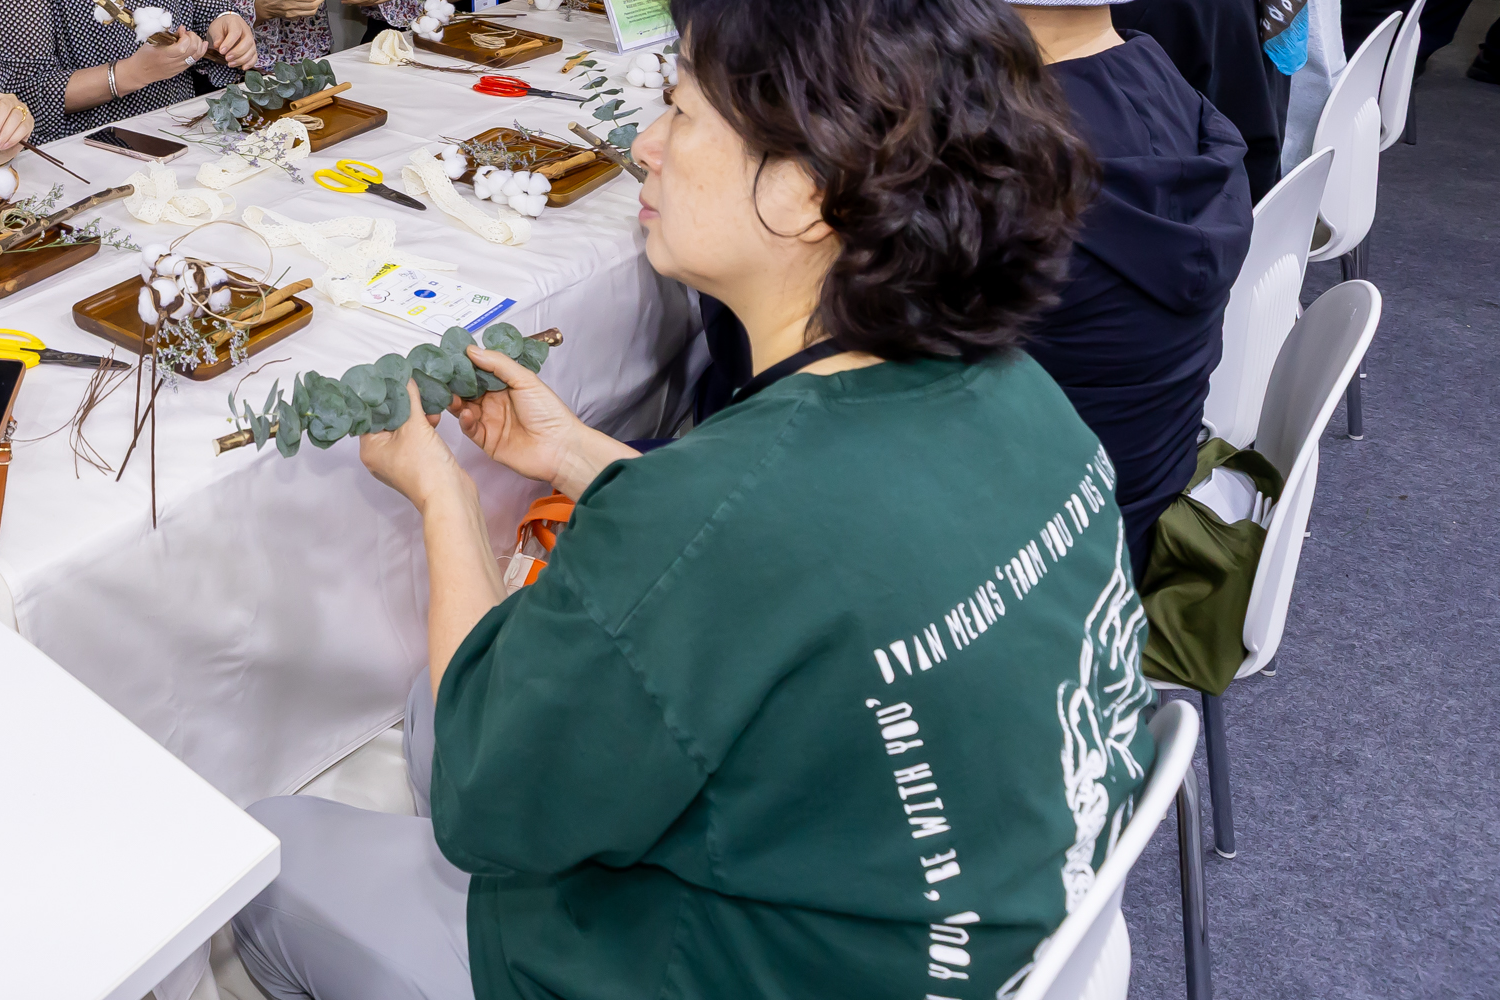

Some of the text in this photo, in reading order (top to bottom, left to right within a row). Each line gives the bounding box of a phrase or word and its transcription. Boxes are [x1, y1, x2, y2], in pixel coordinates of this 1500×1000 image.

[944, 579, 1006, 651] MEANS
[1039, 512, 1074, 563] YOU
[1064, 492, 1090, 535] TO
[893, 762, 952, 839] WITH
